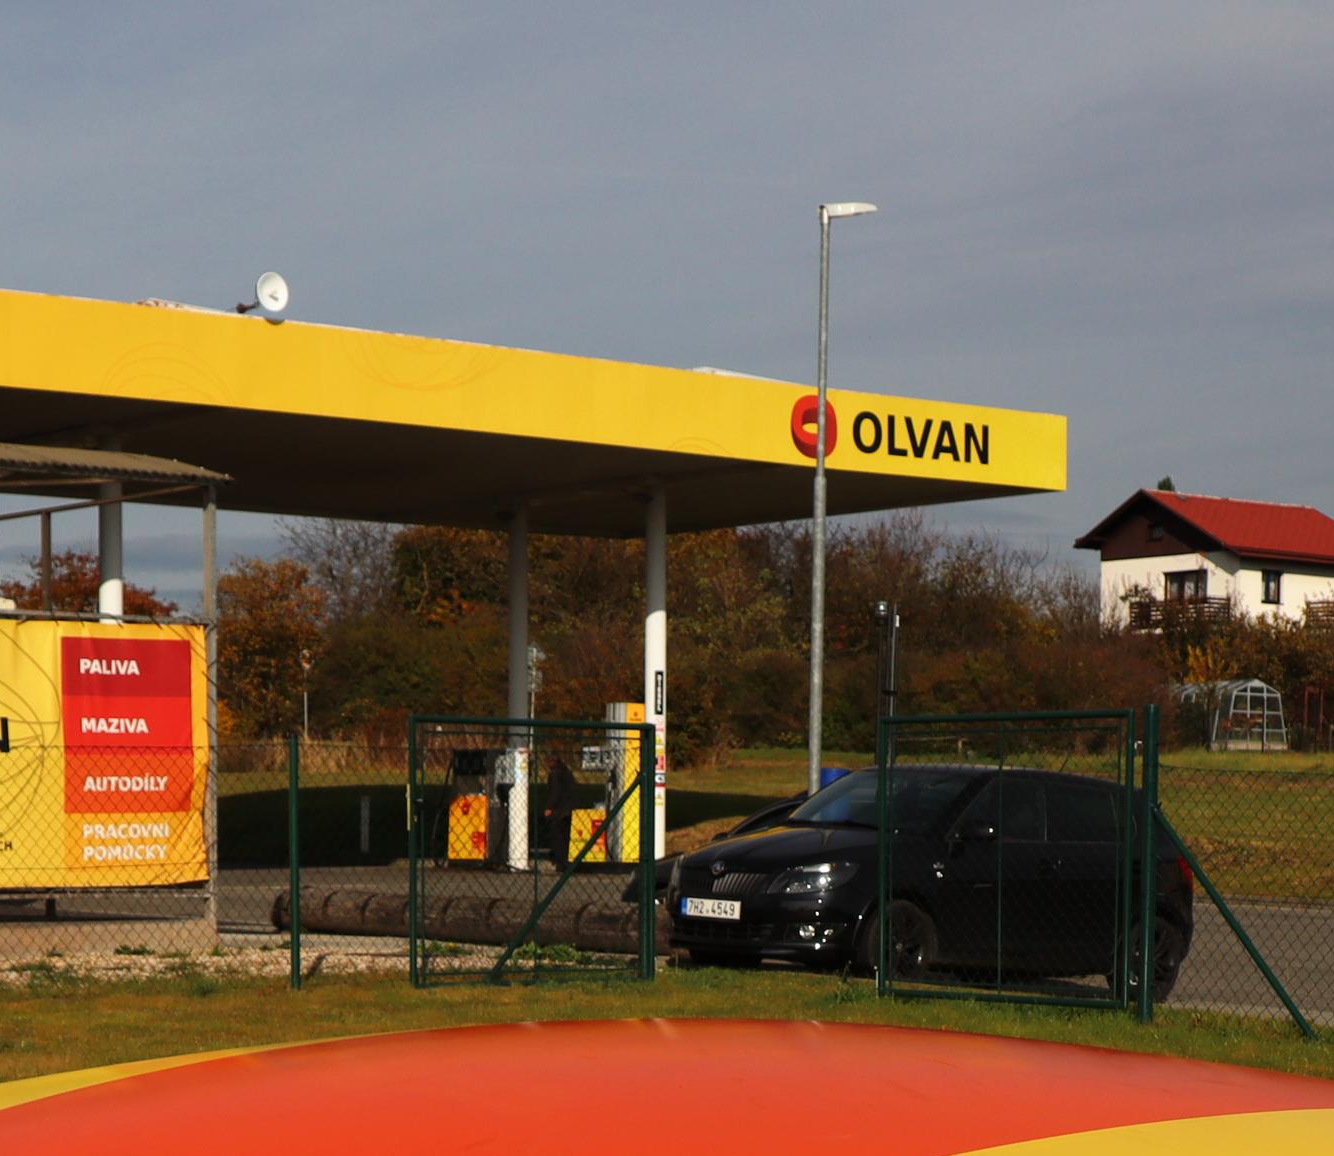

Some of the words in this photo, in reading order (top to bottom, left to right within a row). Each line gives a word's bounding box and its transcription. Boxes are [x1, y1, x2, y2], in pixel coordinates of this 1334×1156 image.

[852, 411, 989, 465] OLVAN
[79, 658, 140, 676] PALIVA
[81, 717, 149, 733] MAZIVA
[84, 772, 168, 792] AUTODÍLY
[83, 823, 170, 839] PRACOVNÍ
[83, 842, 167, 861] POMŮCKY
